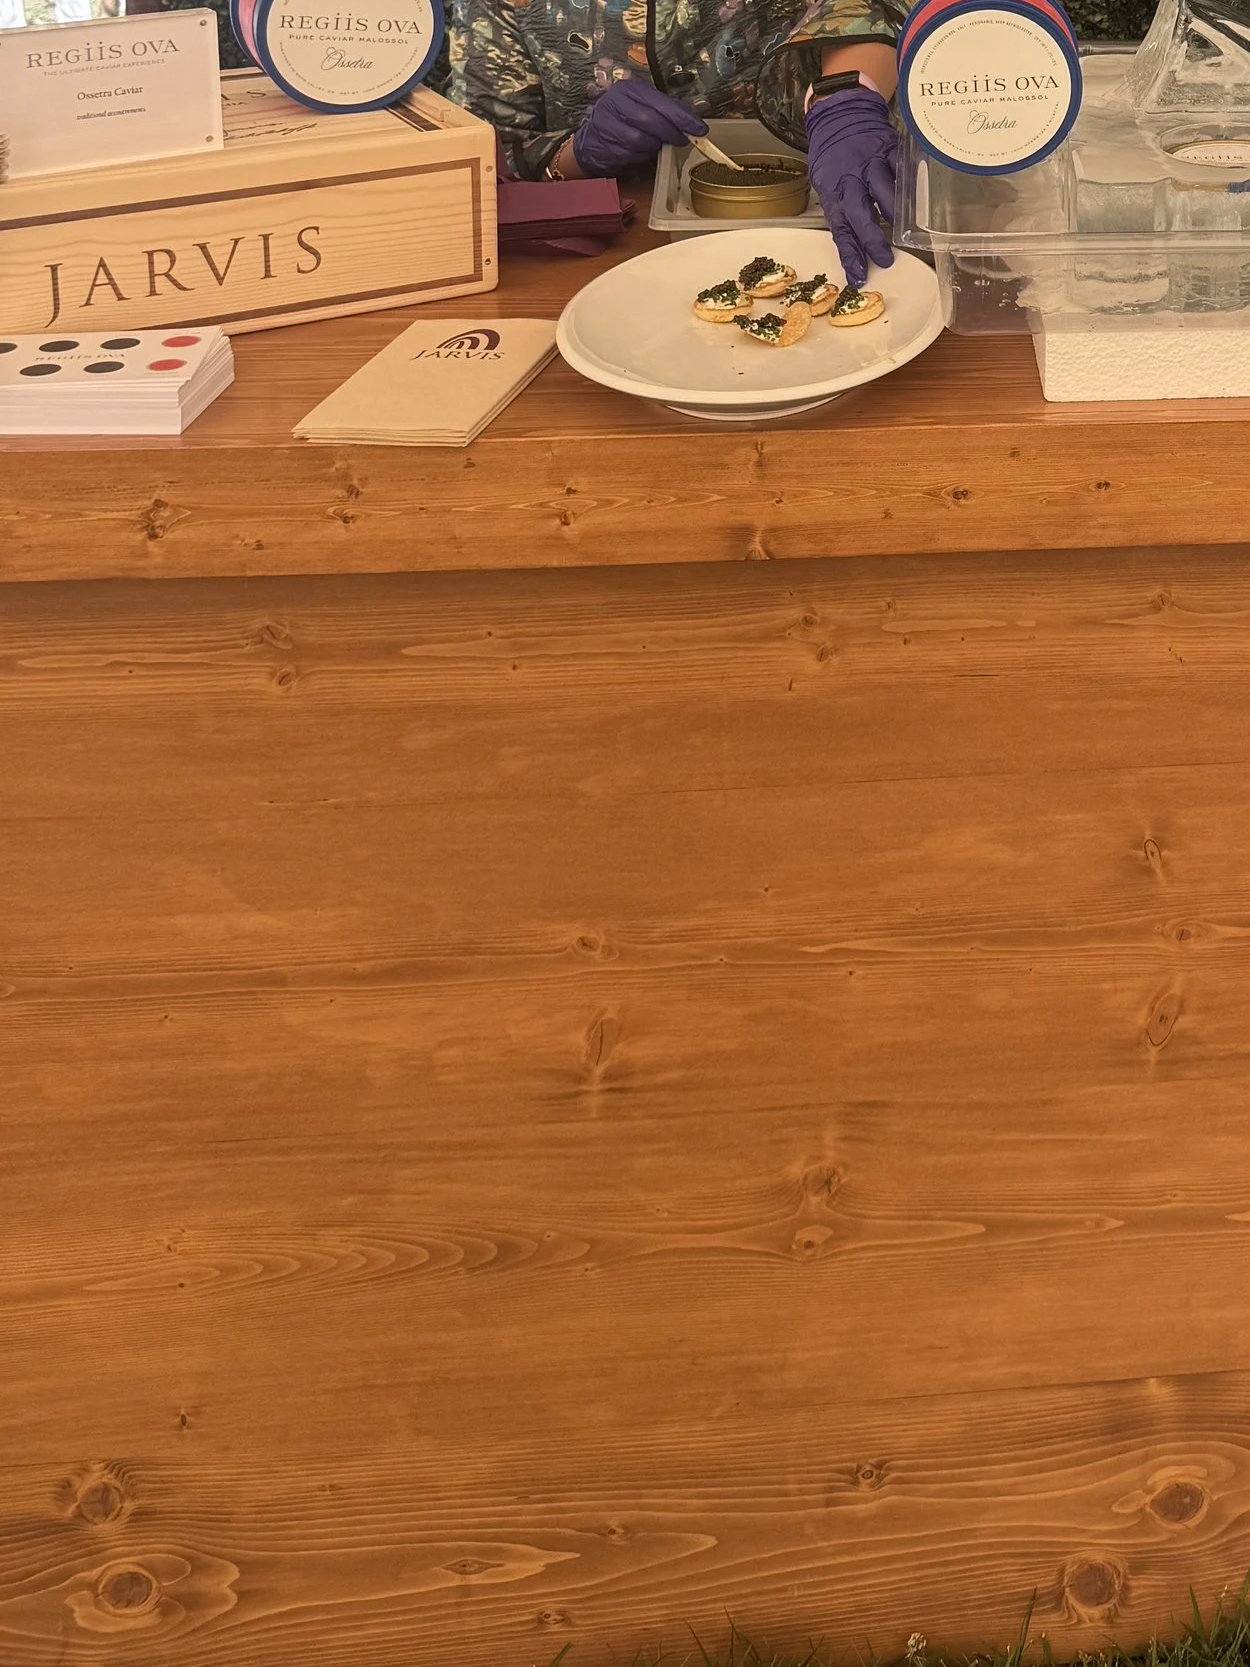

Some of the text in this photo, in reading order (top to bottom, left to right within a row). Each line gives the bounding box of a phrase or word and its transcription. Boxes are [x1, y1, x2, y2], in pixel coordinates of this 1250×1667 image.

[377, 19, 422, 34] OVA
[131, 39, 180, 56] OVA
[59, 67, 93, 75] ULTIMATE
[96, 63, 121, 71] CAVIAR
[123, 59, 165, 68] EXPERIENCE
[320, 47, 374, 71] Ossetra
[1015, 75, 1060, 90] OVA
[77, 86, 143, 101] Ossetra Caviar
[967, 110, 1017, 134] Ossetra
[43, 225, 324, 328] JARVIS
[409, 350, 505, 361] JARVIS
